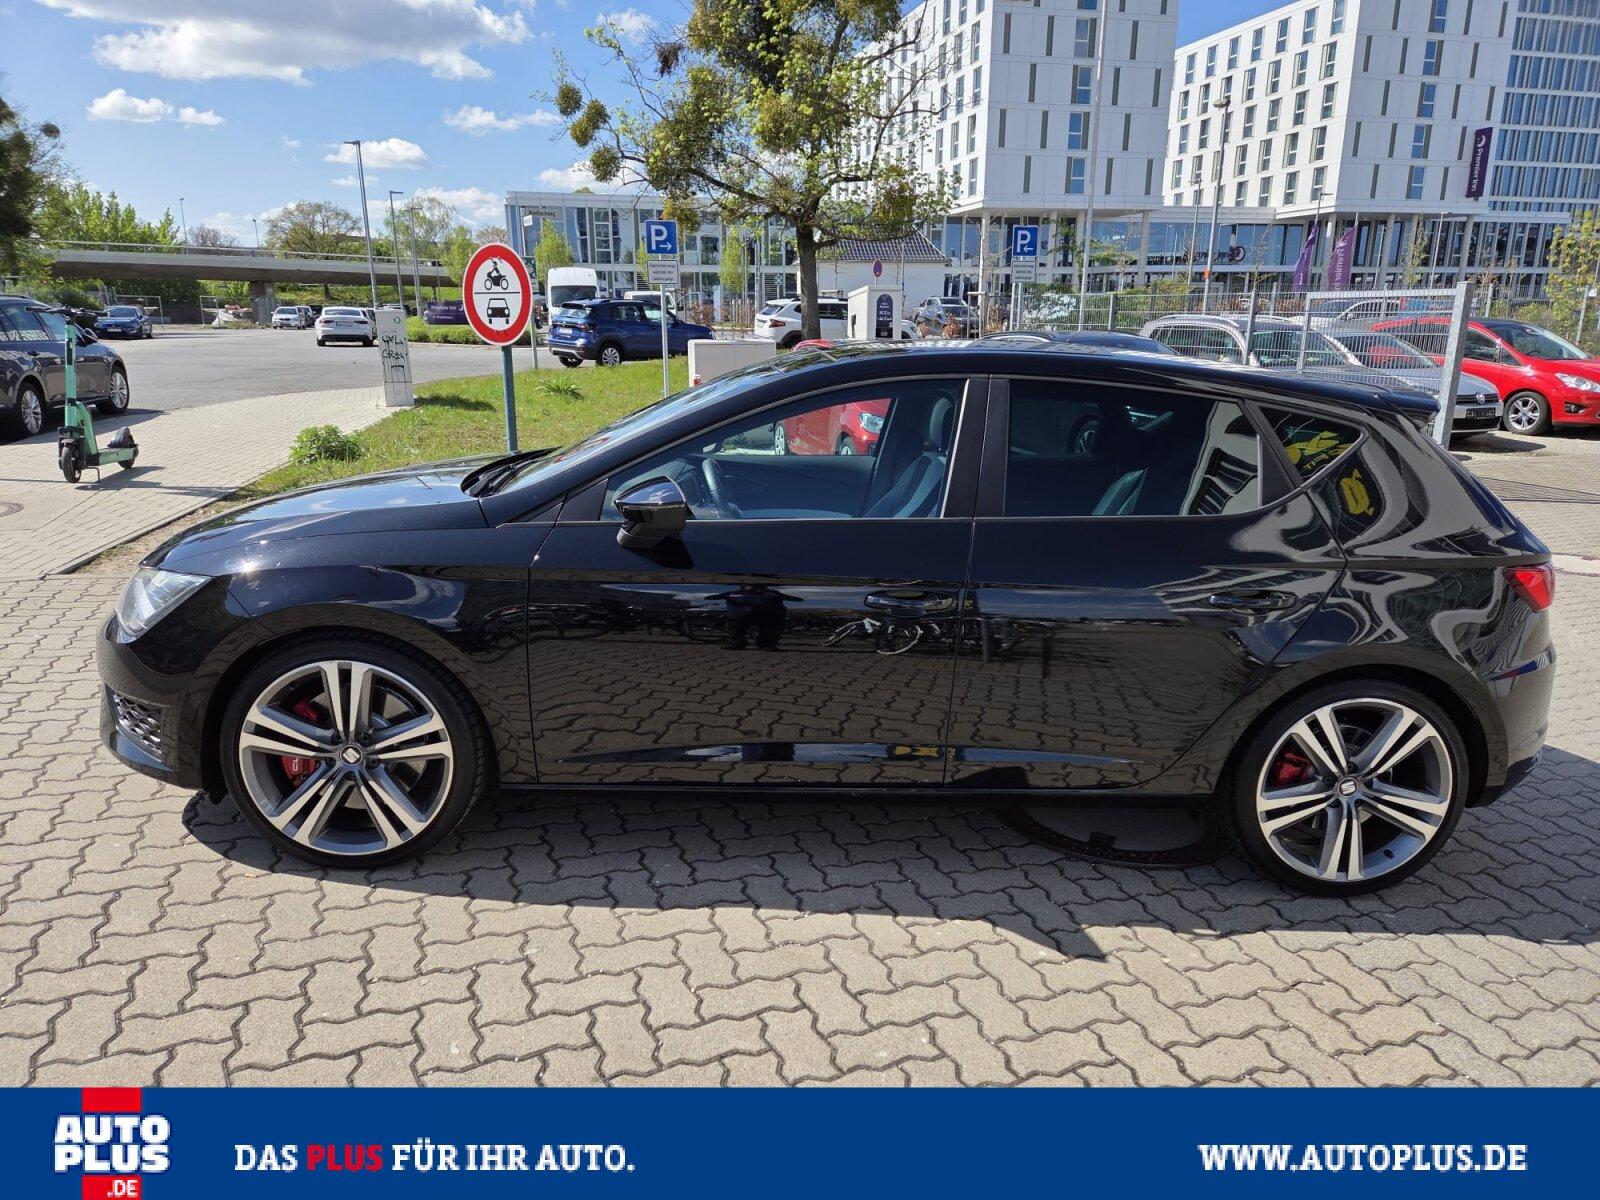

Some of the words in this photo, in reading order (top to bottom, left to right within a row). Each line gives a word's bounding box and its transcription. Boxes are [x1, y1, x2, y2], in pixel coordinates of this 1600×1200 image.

[1473, 148, 1484, 178] Premier
[1471, 179, 1479, 192] Inn
[651, 225, 668, 250] P
[1017, 230, 1031, 253] P
